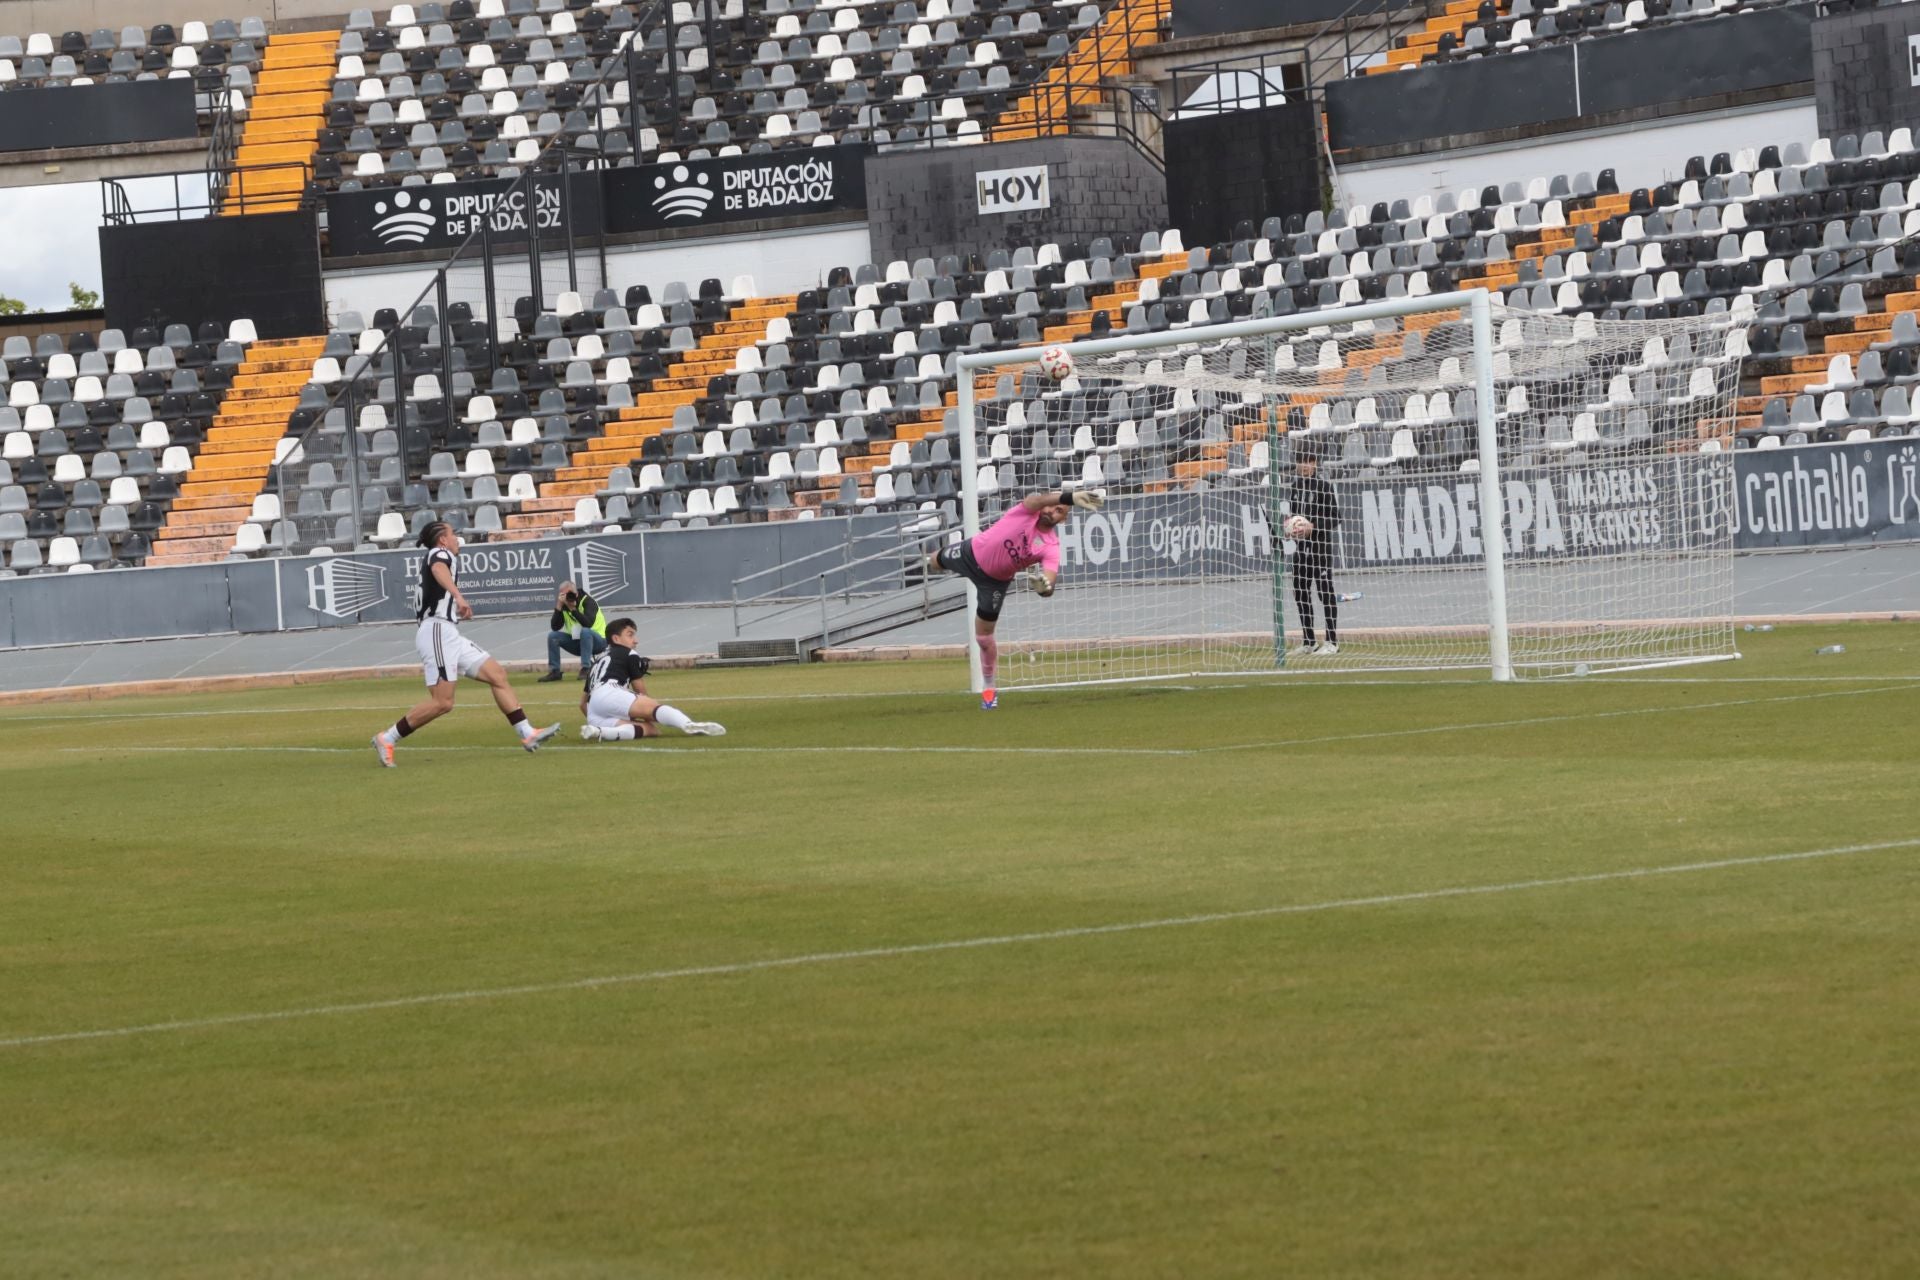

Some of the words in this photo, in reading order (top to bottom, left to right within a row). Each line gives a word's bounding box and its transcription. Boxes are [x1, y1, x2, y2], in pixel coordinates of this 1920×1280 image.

[723, 157, 833, 190] DIPUTACIÓN
[446, 184, 560, 216] DIPUTACÓN
[724, 195, 743, 210] DE
[747, 181, 834, 208] BADAJOZ
[979, 174, 1046, 206] HOY
[447, 221, 465, 235] DE
[471, 208, 561, 233] BDAOZ
[1567, 466, 1658, 506] MADERAS
[1362, 478, 1565, 560] MADEPA
[1570, 508, 1661, 547] PACENSES
[1058, 512, 1135, 566] HOY
[1150, 516, 1230, 560] Oferplan
[404, 551, 500, 577] HROS
[505, 548, 552, 571] DIAZ
[485, 577, 513, 587] CÁCERES
[518, 576, 554, 585] SALAMANCA
